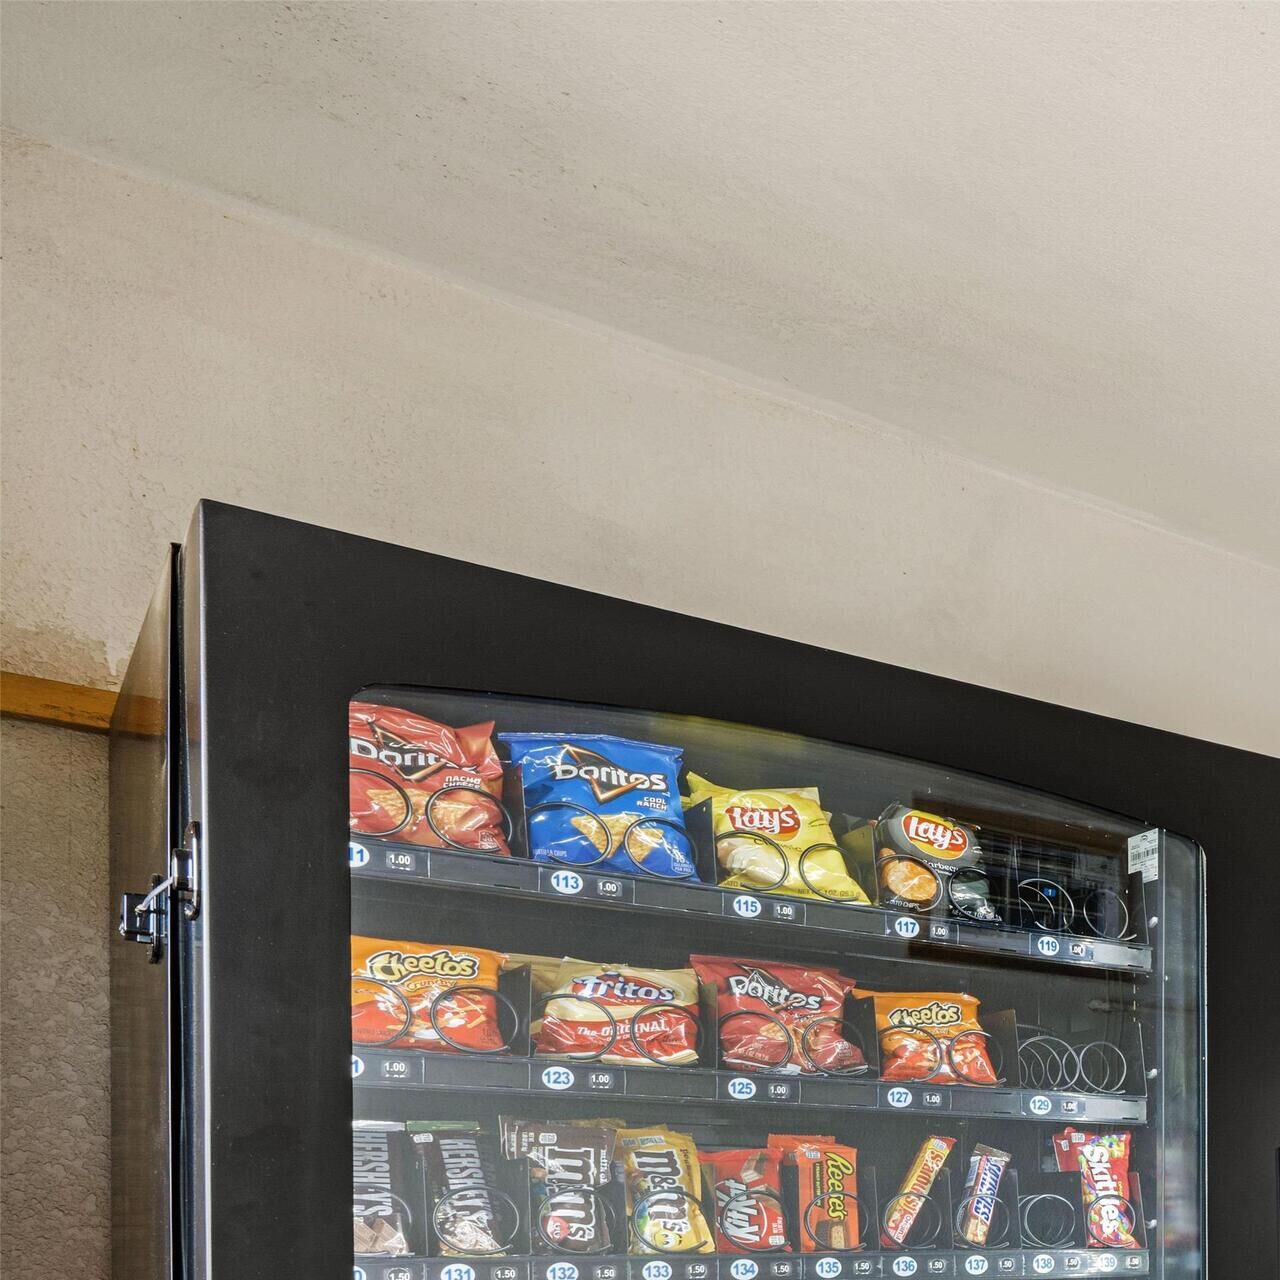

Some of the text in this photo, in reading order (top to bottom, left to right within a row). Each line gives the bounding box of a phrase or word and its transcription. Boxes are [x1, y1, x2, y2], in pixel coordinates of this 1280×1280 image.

[555, 763, 667, 790] Doritos
[636, 801, 667, 811] RANCH
[644, 796, 667, 805] COOL
[909, 816, 964, 850] Lay's
[389, 853, 411, 865] 1.00
[553, 875, 617, 892] 113 1.00
[735, 899, 793, 916] 115 1.00
[896, 922, 947, 936] 117 1.00
[1039, 940, 1058, 953] 119
[369, 951, 478, 984] Cheetos
[729, 976, 822, 1010] Doritos
[889, 1002, 961, 1027] Cheetos
[384, 1062, 406, 1073] 1.00
[544, 1071, 610, 1085] 123 1.00
[730, 1082, 786, 1095] 125 1.00
[890, 1091, 940, 1103] 127 1.00
[1032, 1099, 1050, 1111] 129
[732, 1264, 756, 1275] 134
[818, 1262, 869, 1274] 135 1.50
[895, 1260, 943, 1272] 136 1.50
[967, 1258, 1013, 1270] 137 1.50
[1034, 1257, 1053, 1269] 138
[496, 1269, 516, 1279] 1.50
[549, 1267, 615, 1280] 132 1.50
[645, 1265, 705, 1278] 133 1.50
